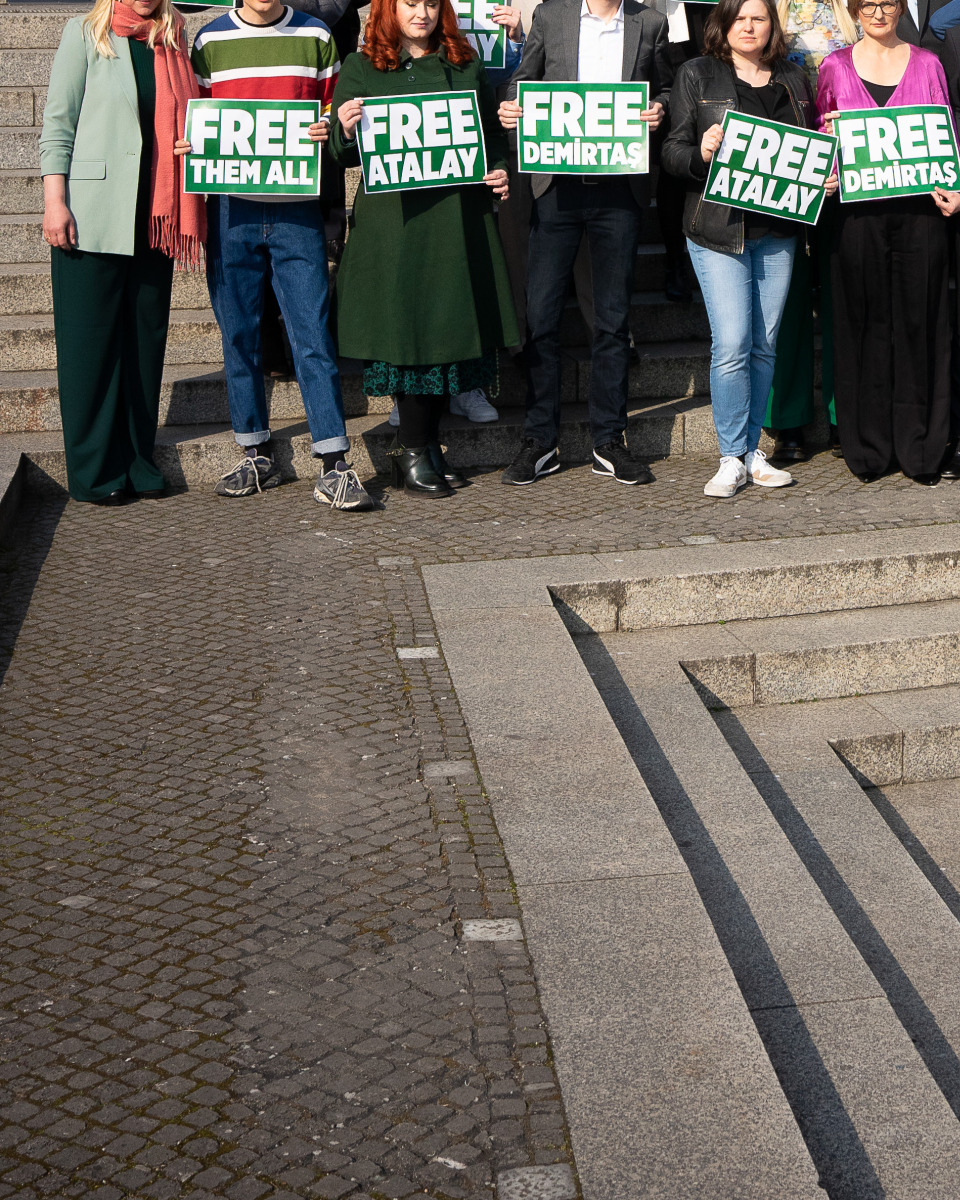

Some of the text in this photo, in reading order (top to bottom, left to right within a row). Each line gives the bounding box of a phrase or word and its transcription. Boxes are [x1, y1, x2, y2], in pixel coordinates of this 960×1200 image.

[190, 108, 315, 157] FREE
[360, 98, 479, 153] FREE
[523, 91, 643, 137] FREE
[523, 138, 643, 169] DEMİRTAŞ
[716, 118, 833, 186] FREE
[838, 113, 954, 165] FREE
[189, 159, 314, 185] THEM ALL
[368, 147, 479, 186] ATALAY
[843, 161, 957, 193] DEMİRTAŞ
[709, 166, 820, 215] ATALAY
